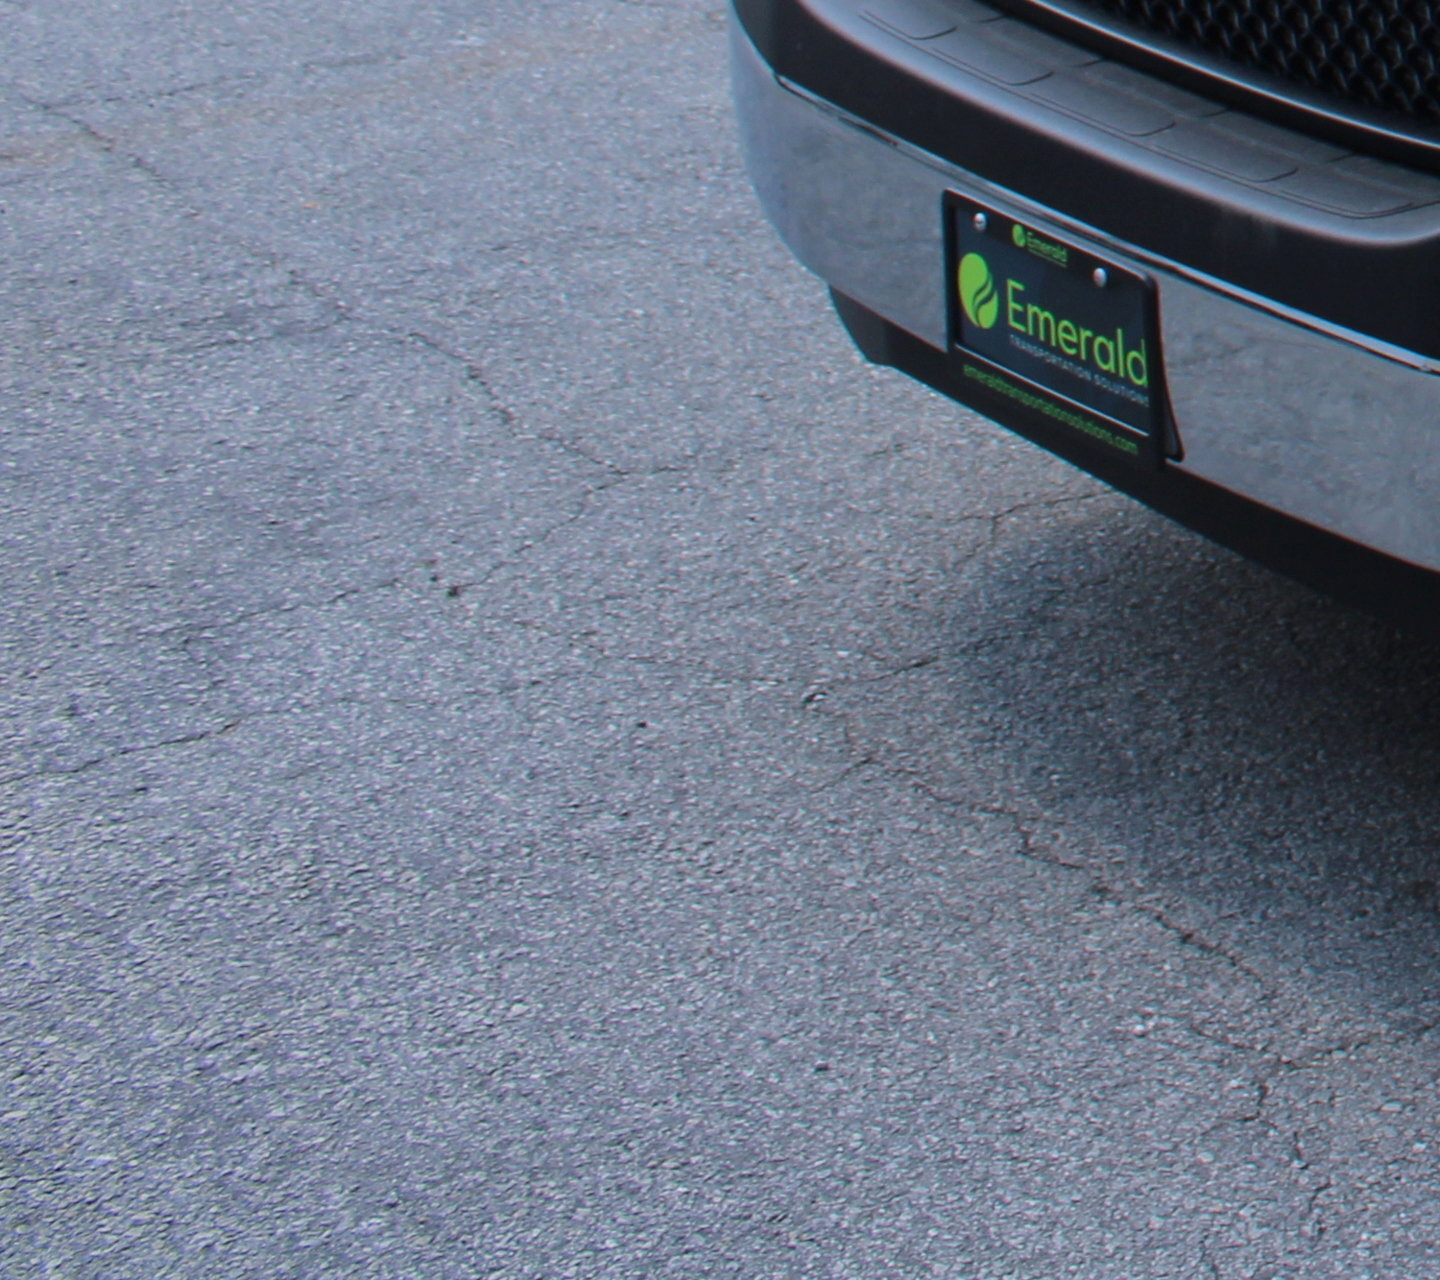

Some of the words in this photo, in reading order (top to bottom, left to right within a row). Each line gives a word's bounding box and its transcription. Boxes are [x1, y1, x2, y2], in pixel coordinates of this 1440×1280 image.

[1006, 278, 1149, 387] Emerald
[1009, 333, 1092, 382] TRANSPORTATION
[1094, 373, 1150, 408] SOLUTIONS
